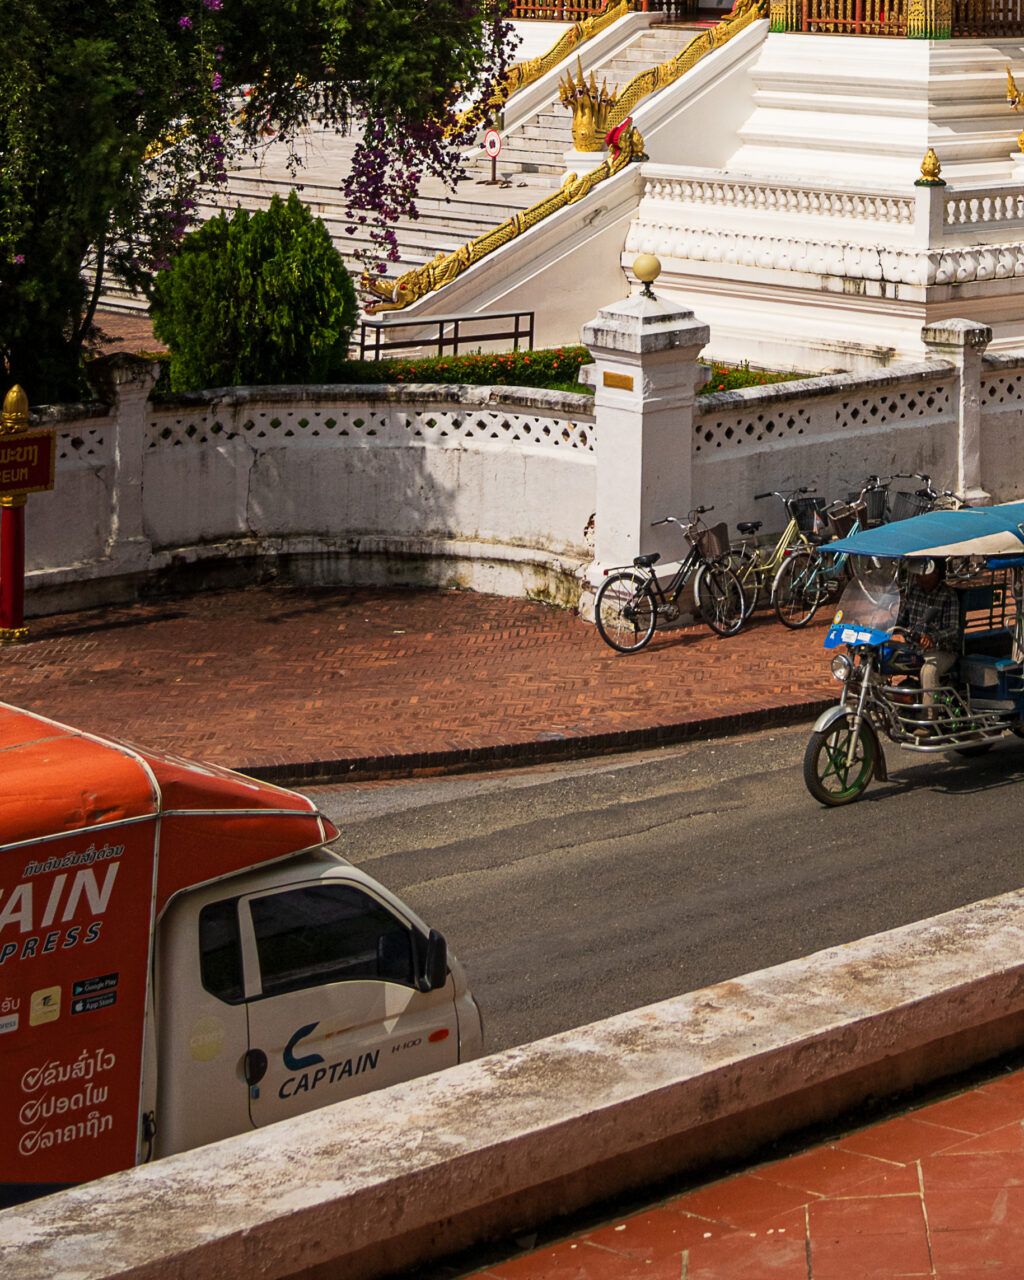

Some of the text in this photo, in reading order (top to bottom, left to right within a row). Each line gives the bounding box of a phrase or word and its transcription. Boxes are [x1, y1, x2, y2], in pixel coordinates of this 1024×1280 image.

[0, 468, 28, 483] EUM
[0, 862, 120, 933] AIN
[278, 1049, 380, 1100] CAPTAIN
